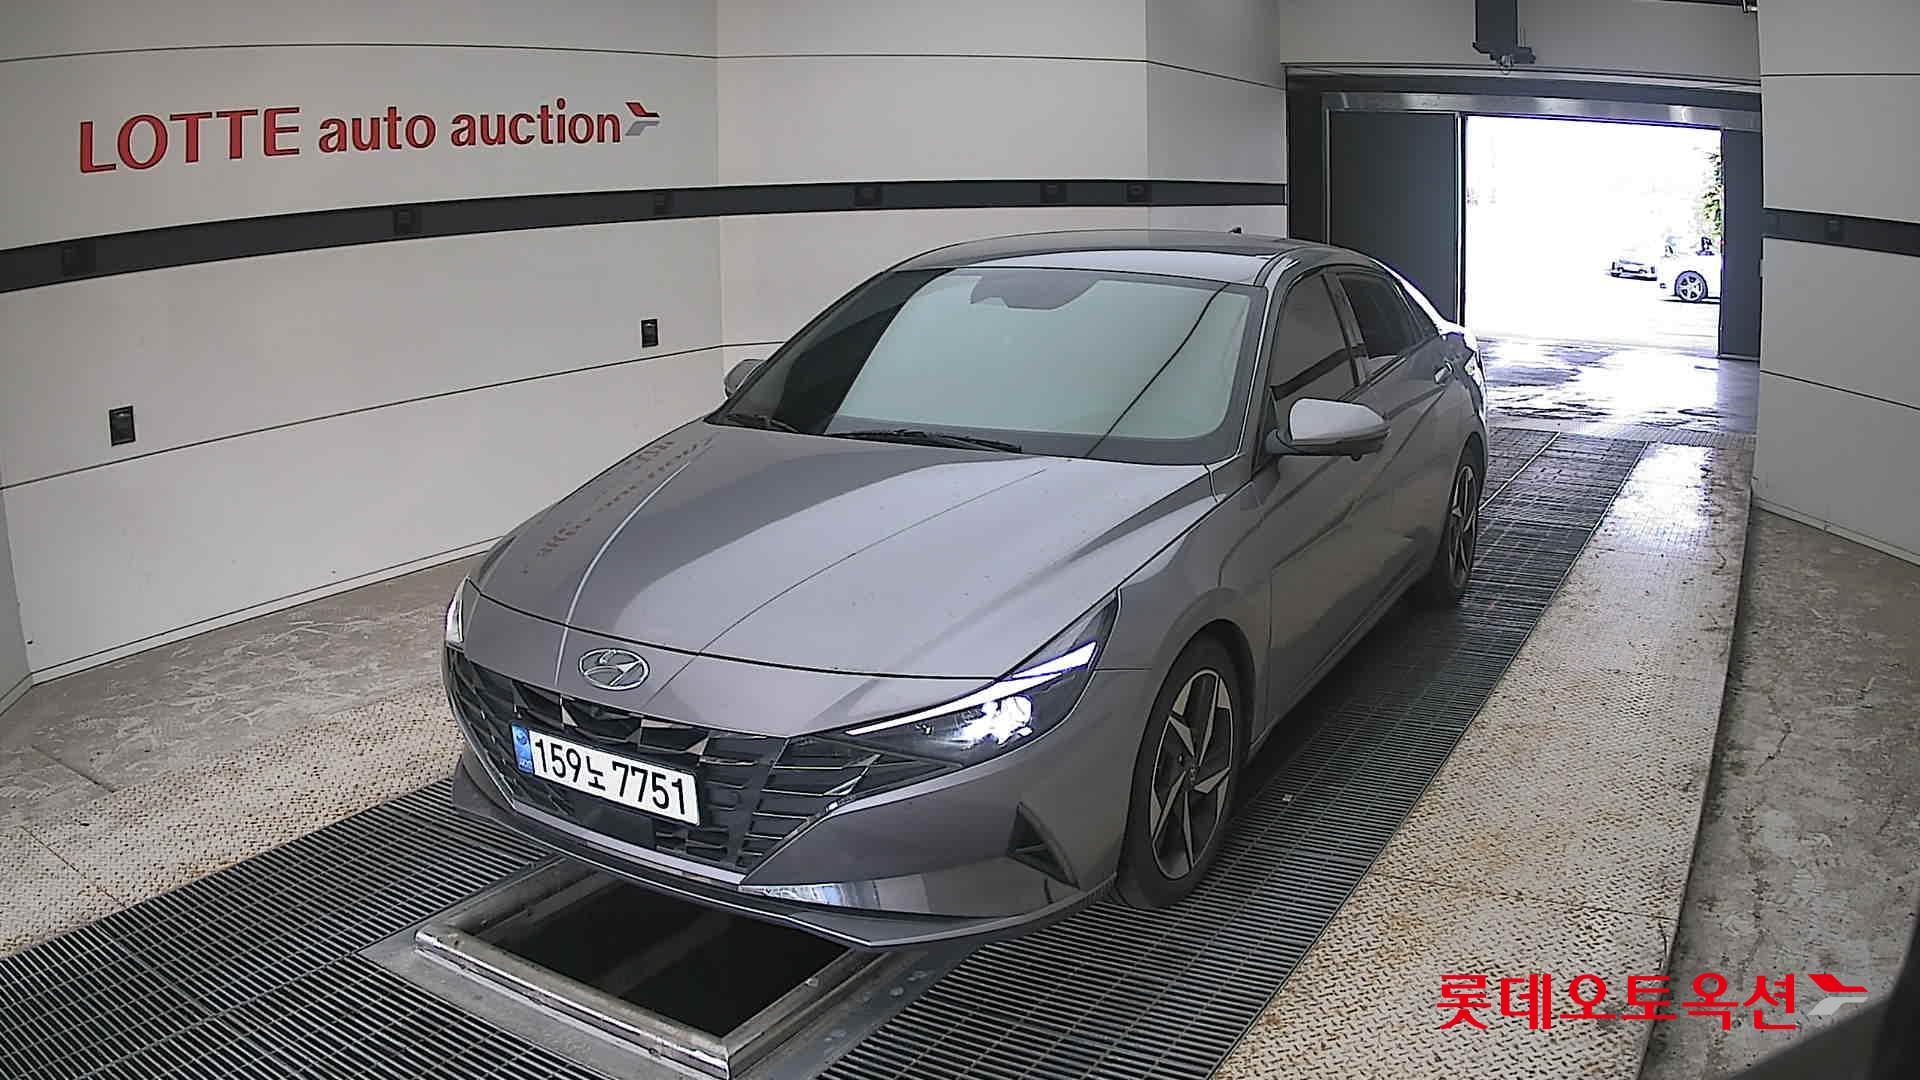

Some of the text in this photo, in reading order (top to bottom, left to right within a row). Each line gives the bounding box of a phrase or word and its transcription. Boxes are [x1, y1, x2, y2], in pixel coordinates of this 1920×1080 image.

[79, 98, 622, 173] LOTTE auto auction
